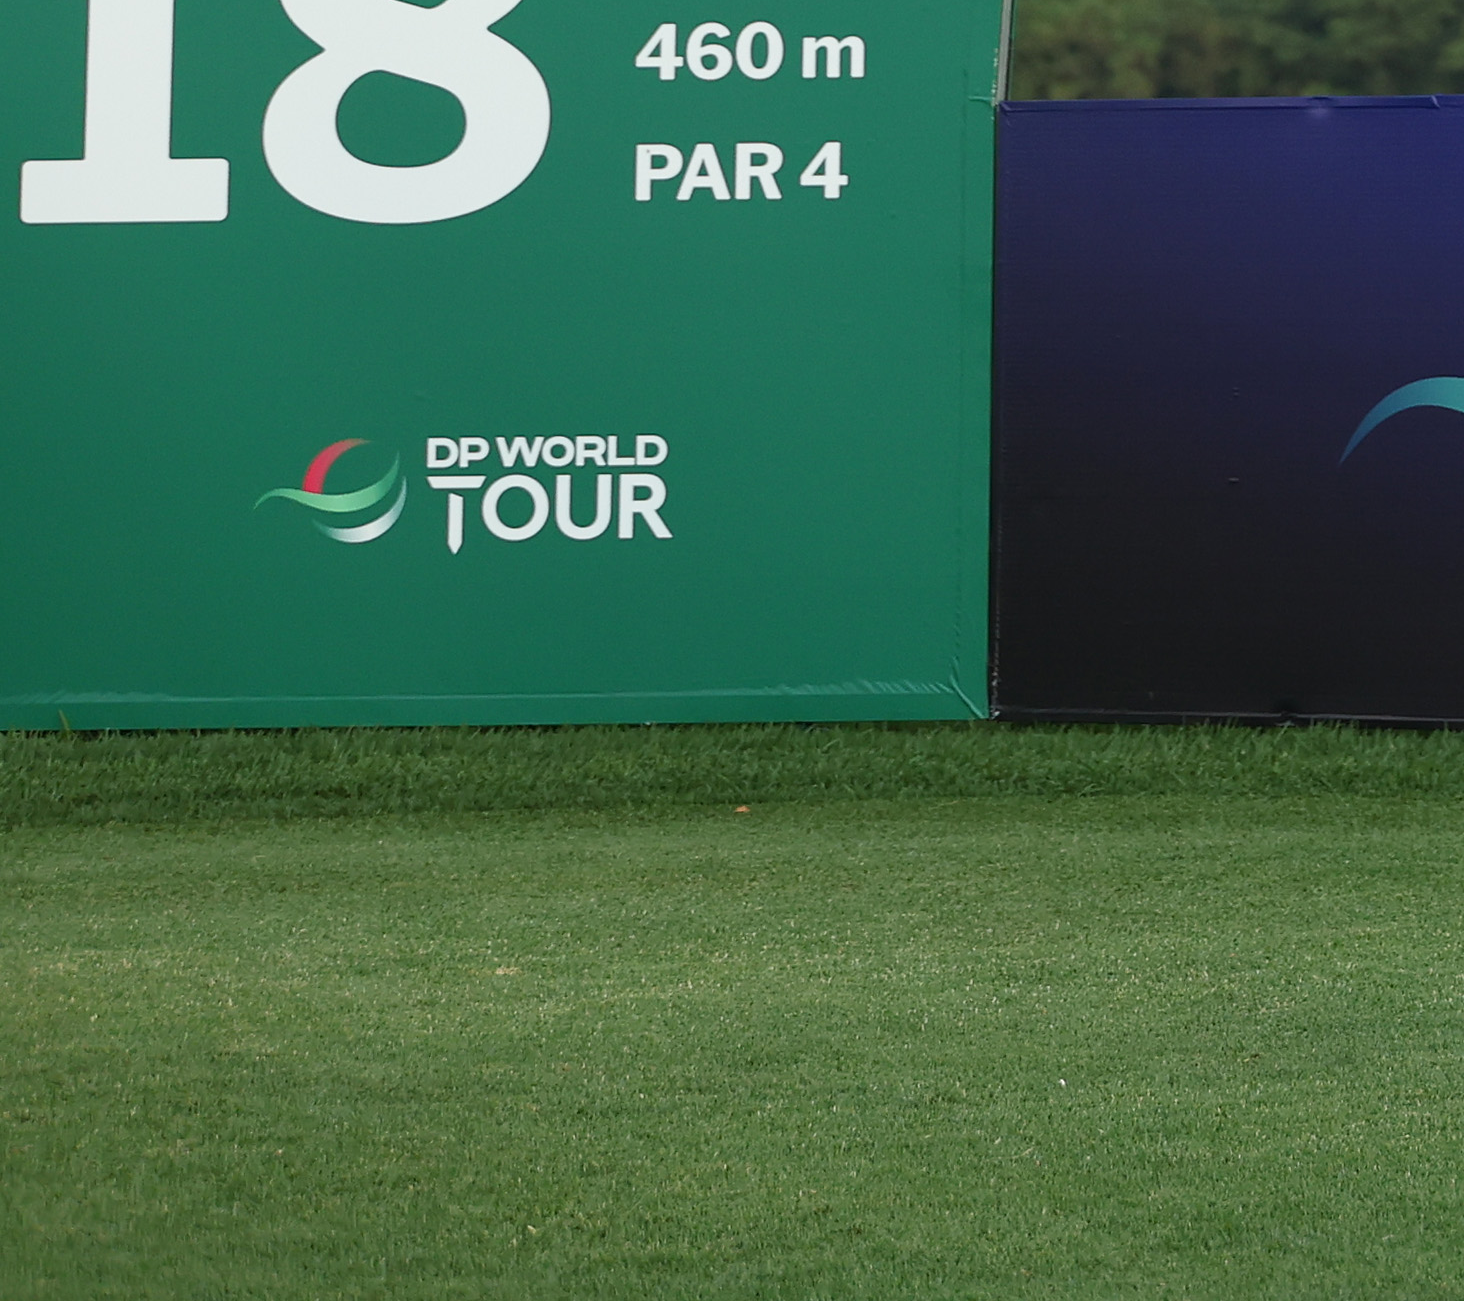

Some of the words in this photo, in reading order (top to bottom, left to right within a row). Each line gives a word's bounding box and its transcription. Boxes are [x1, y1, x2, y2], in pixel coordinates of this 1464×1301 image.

[636, 22, 783, 80] 460
[802, 36, 864, 79] m
[635, 143, 783, 201] PAR
[800, 142, 848, 198] 4
[427, 436, 489, 468] DP
[496, 435, 667, 467] WORLD
[427, 474, 672, 554] TOUR
